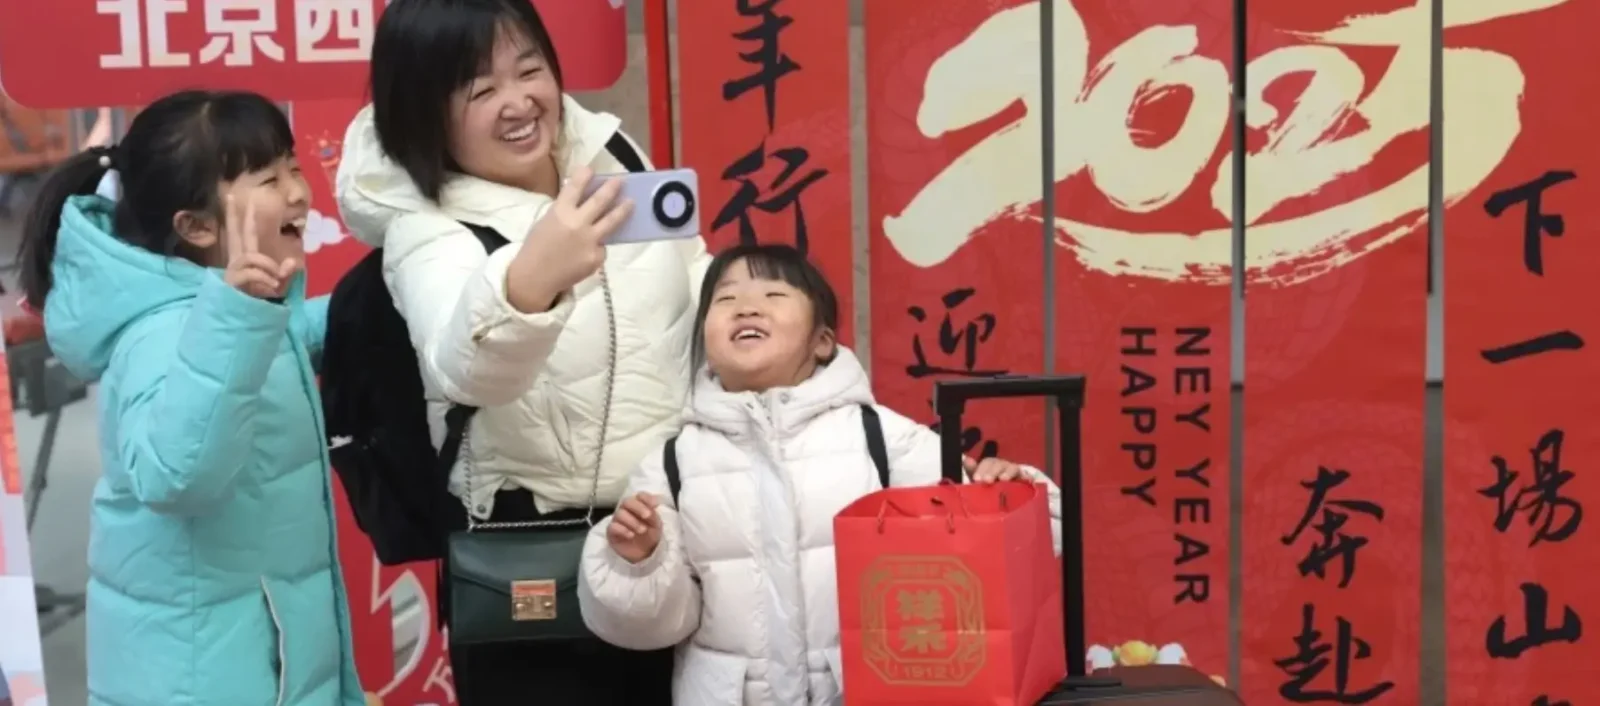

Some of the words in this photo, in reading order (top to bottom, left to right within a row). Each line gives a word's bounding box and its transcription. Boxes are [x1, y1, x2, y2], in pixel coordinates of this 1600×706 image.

[97, 0, 391, 67] 北京西
[883, 0, 1568, 284] 2025
[1121, 327, 1157, 506] HAPPY
[1174, 327, 1211, 432] NEY
[1479, 171, 1585, 706] 下一場山
[1174, 458, 1211, 604] YEAR
[1273, 466, 1395, 704] 奔赴
[903, 666, 948, 679] 1912
